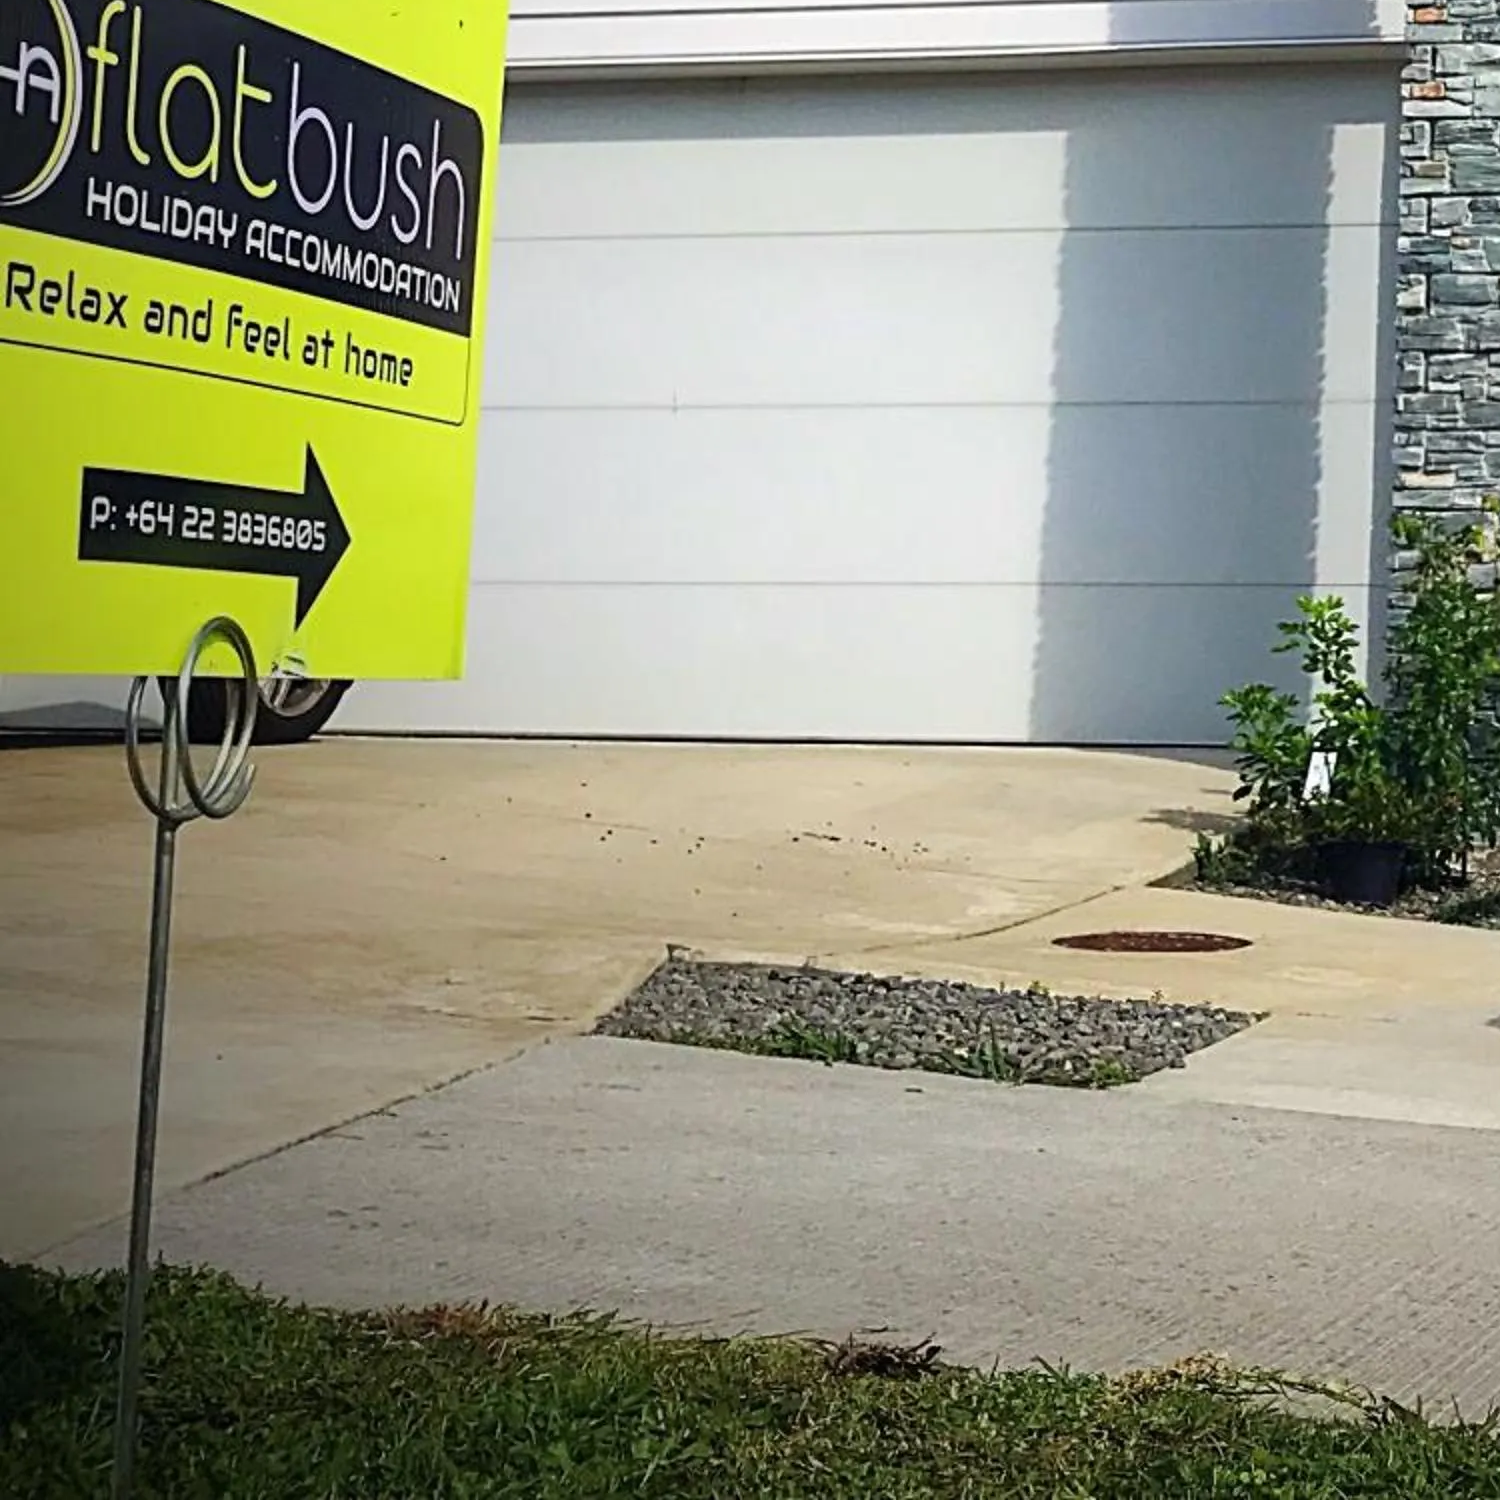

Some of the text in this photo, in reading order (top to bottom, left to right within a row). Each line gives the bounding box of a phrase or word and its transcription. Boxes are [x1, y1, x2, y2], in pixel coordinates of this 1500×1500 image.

[86, 177, 460, 312] HOLIDAY ACCOMMODATION
[6, 261, 413, 387] Relax and feel at home
[90, 496, 326, 551] P: +64 22 3836805
